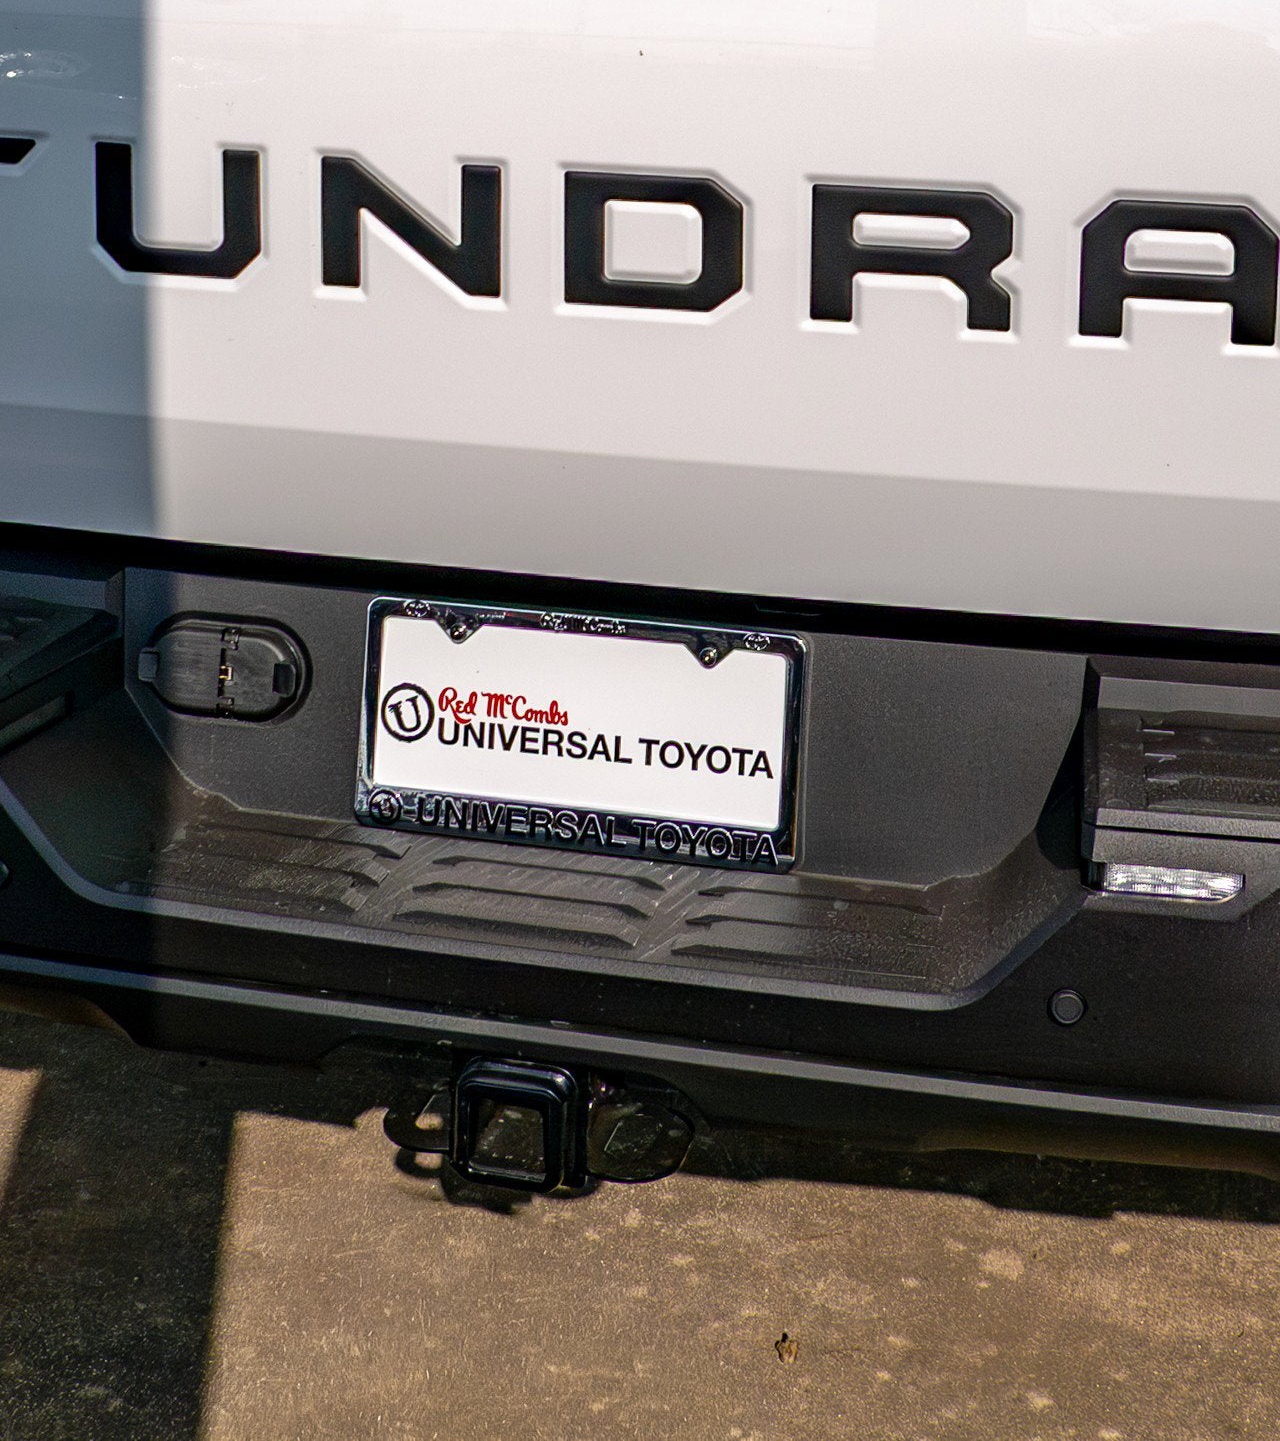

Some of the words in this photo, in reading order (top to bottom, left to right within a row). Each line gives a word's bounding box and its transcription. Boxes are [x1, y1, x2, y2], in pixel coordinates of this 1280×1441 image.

[438, 687, 477, 724] Red
[481, 691, 569, 727] McCombs
[437, 716, 633, 764] UNIVERSAL
[639, 738, 774, 779] TOYOTA
[417, 794, 628, 847] UNIVERSAL
[632, 818, 780, 866] TOYOTA
